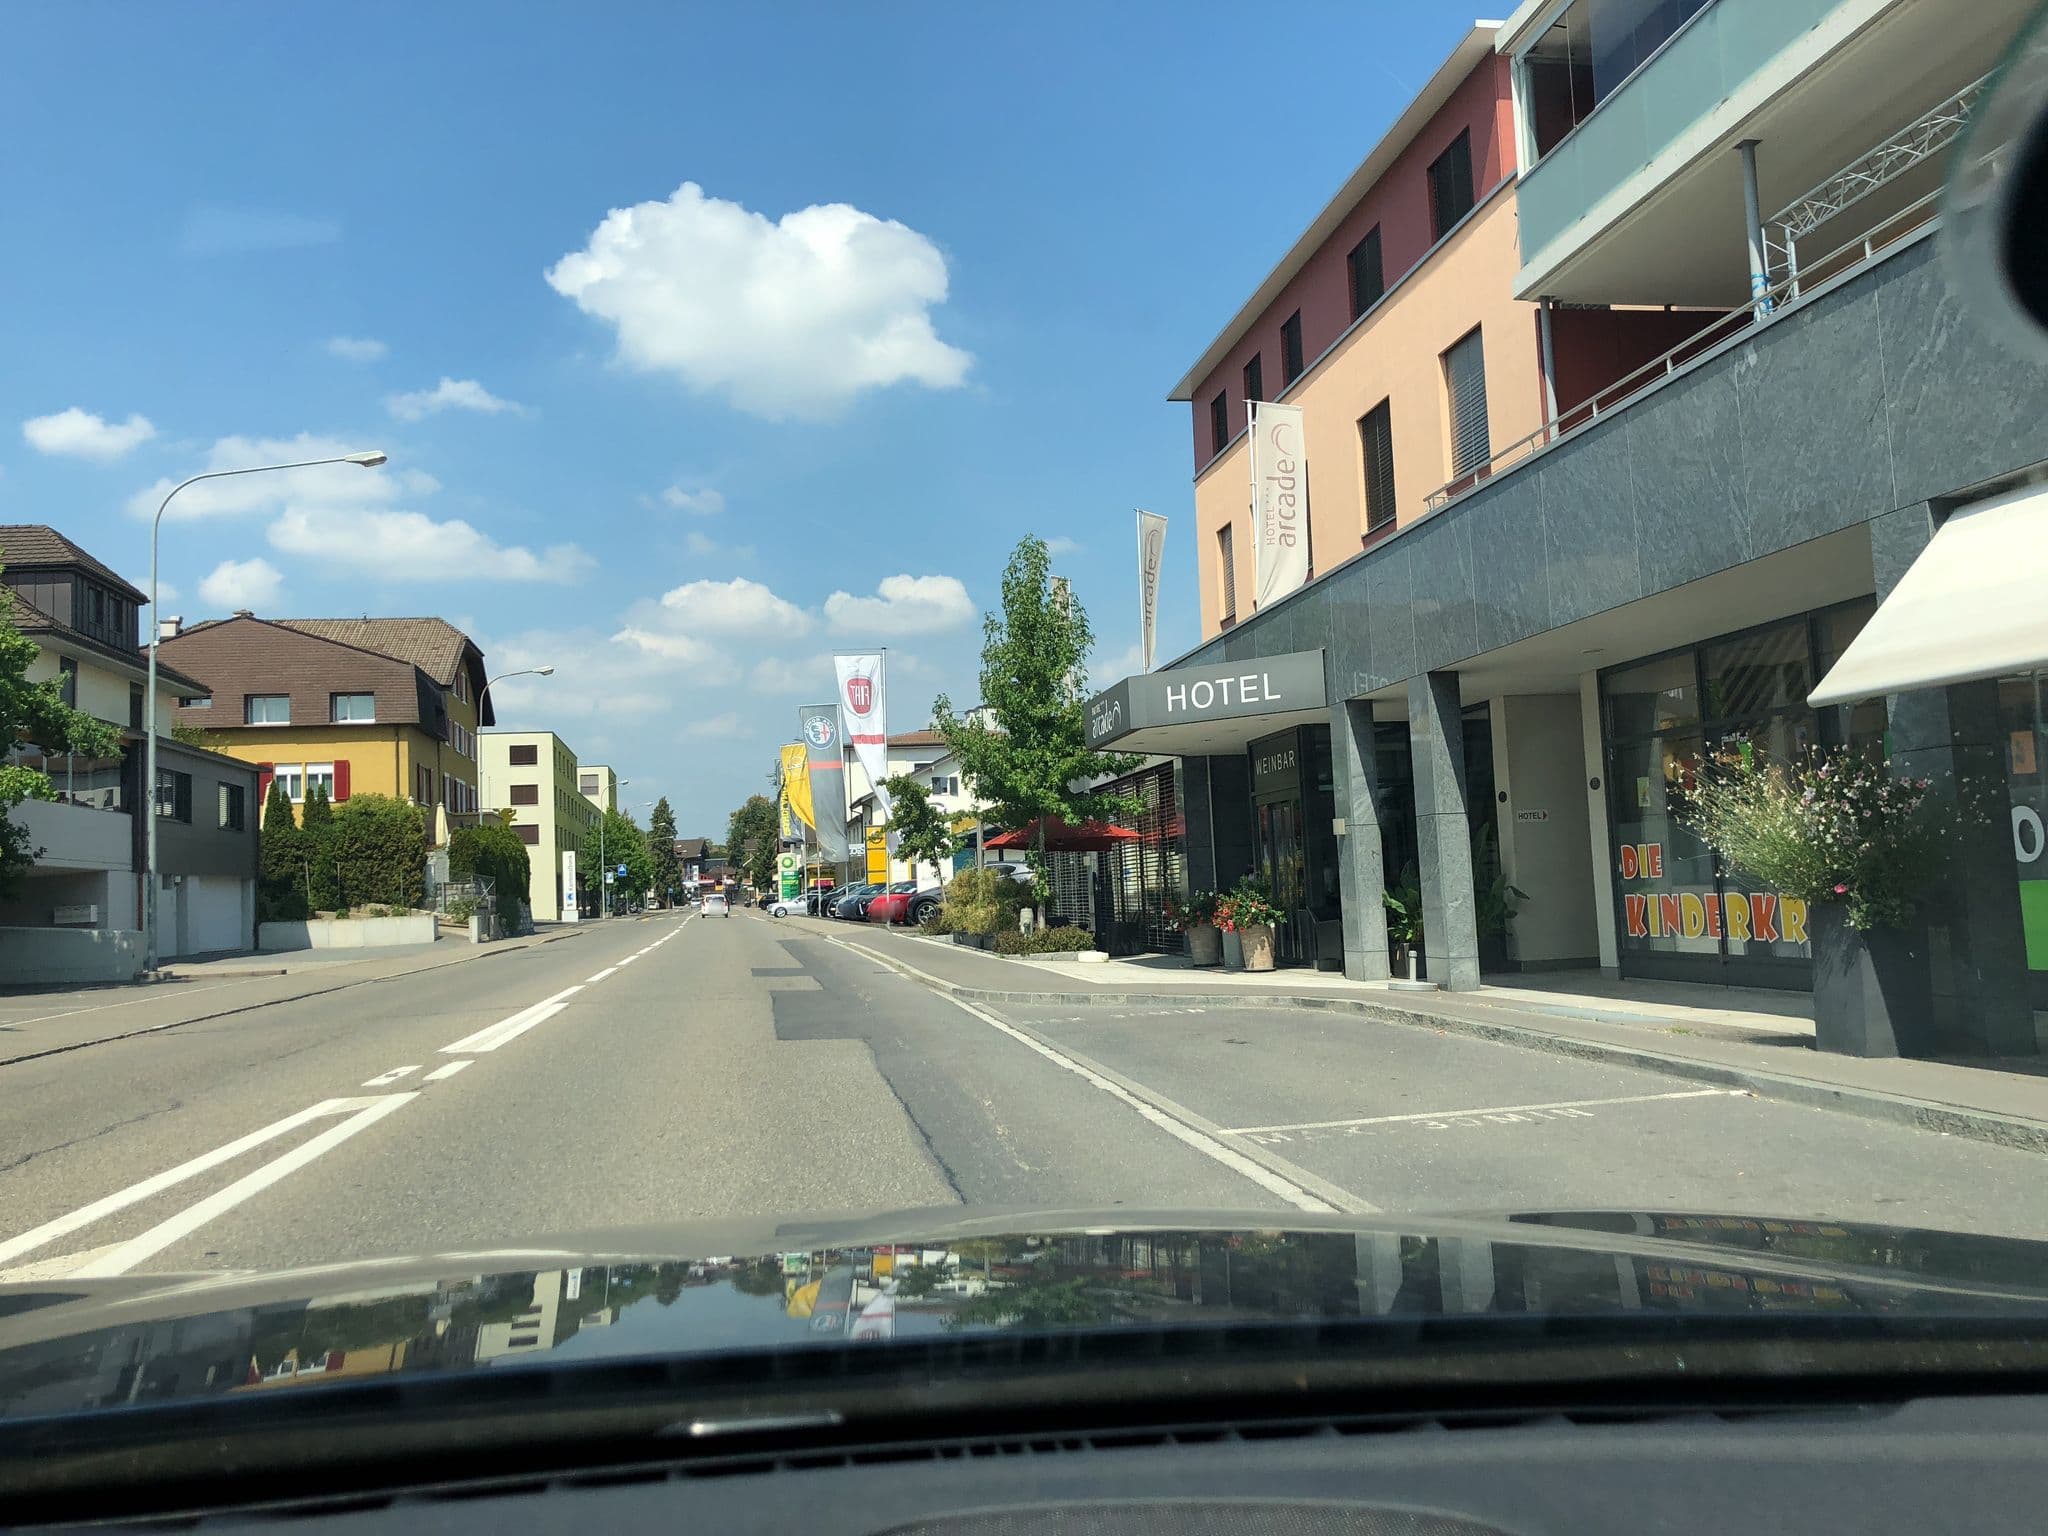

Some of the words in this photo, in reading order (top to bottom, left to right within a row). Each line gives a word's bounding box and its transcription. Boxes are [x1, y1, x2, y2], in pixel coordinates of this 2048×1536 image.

[1265, 458, 1297, 547] arcade
[1266, 506, 1275, 545] HOTEL
[1166, 673, 1281, 712] HOTEL
[1092, 699, 1113, 739] arcade
[1255, 750, 1295, 775] WEINBAR
[1518, 812, 1542, 820] HOTEL
[1621, 843, 1663, 879] DIE
[1625, 892, 1809, 944] KINDERKR
